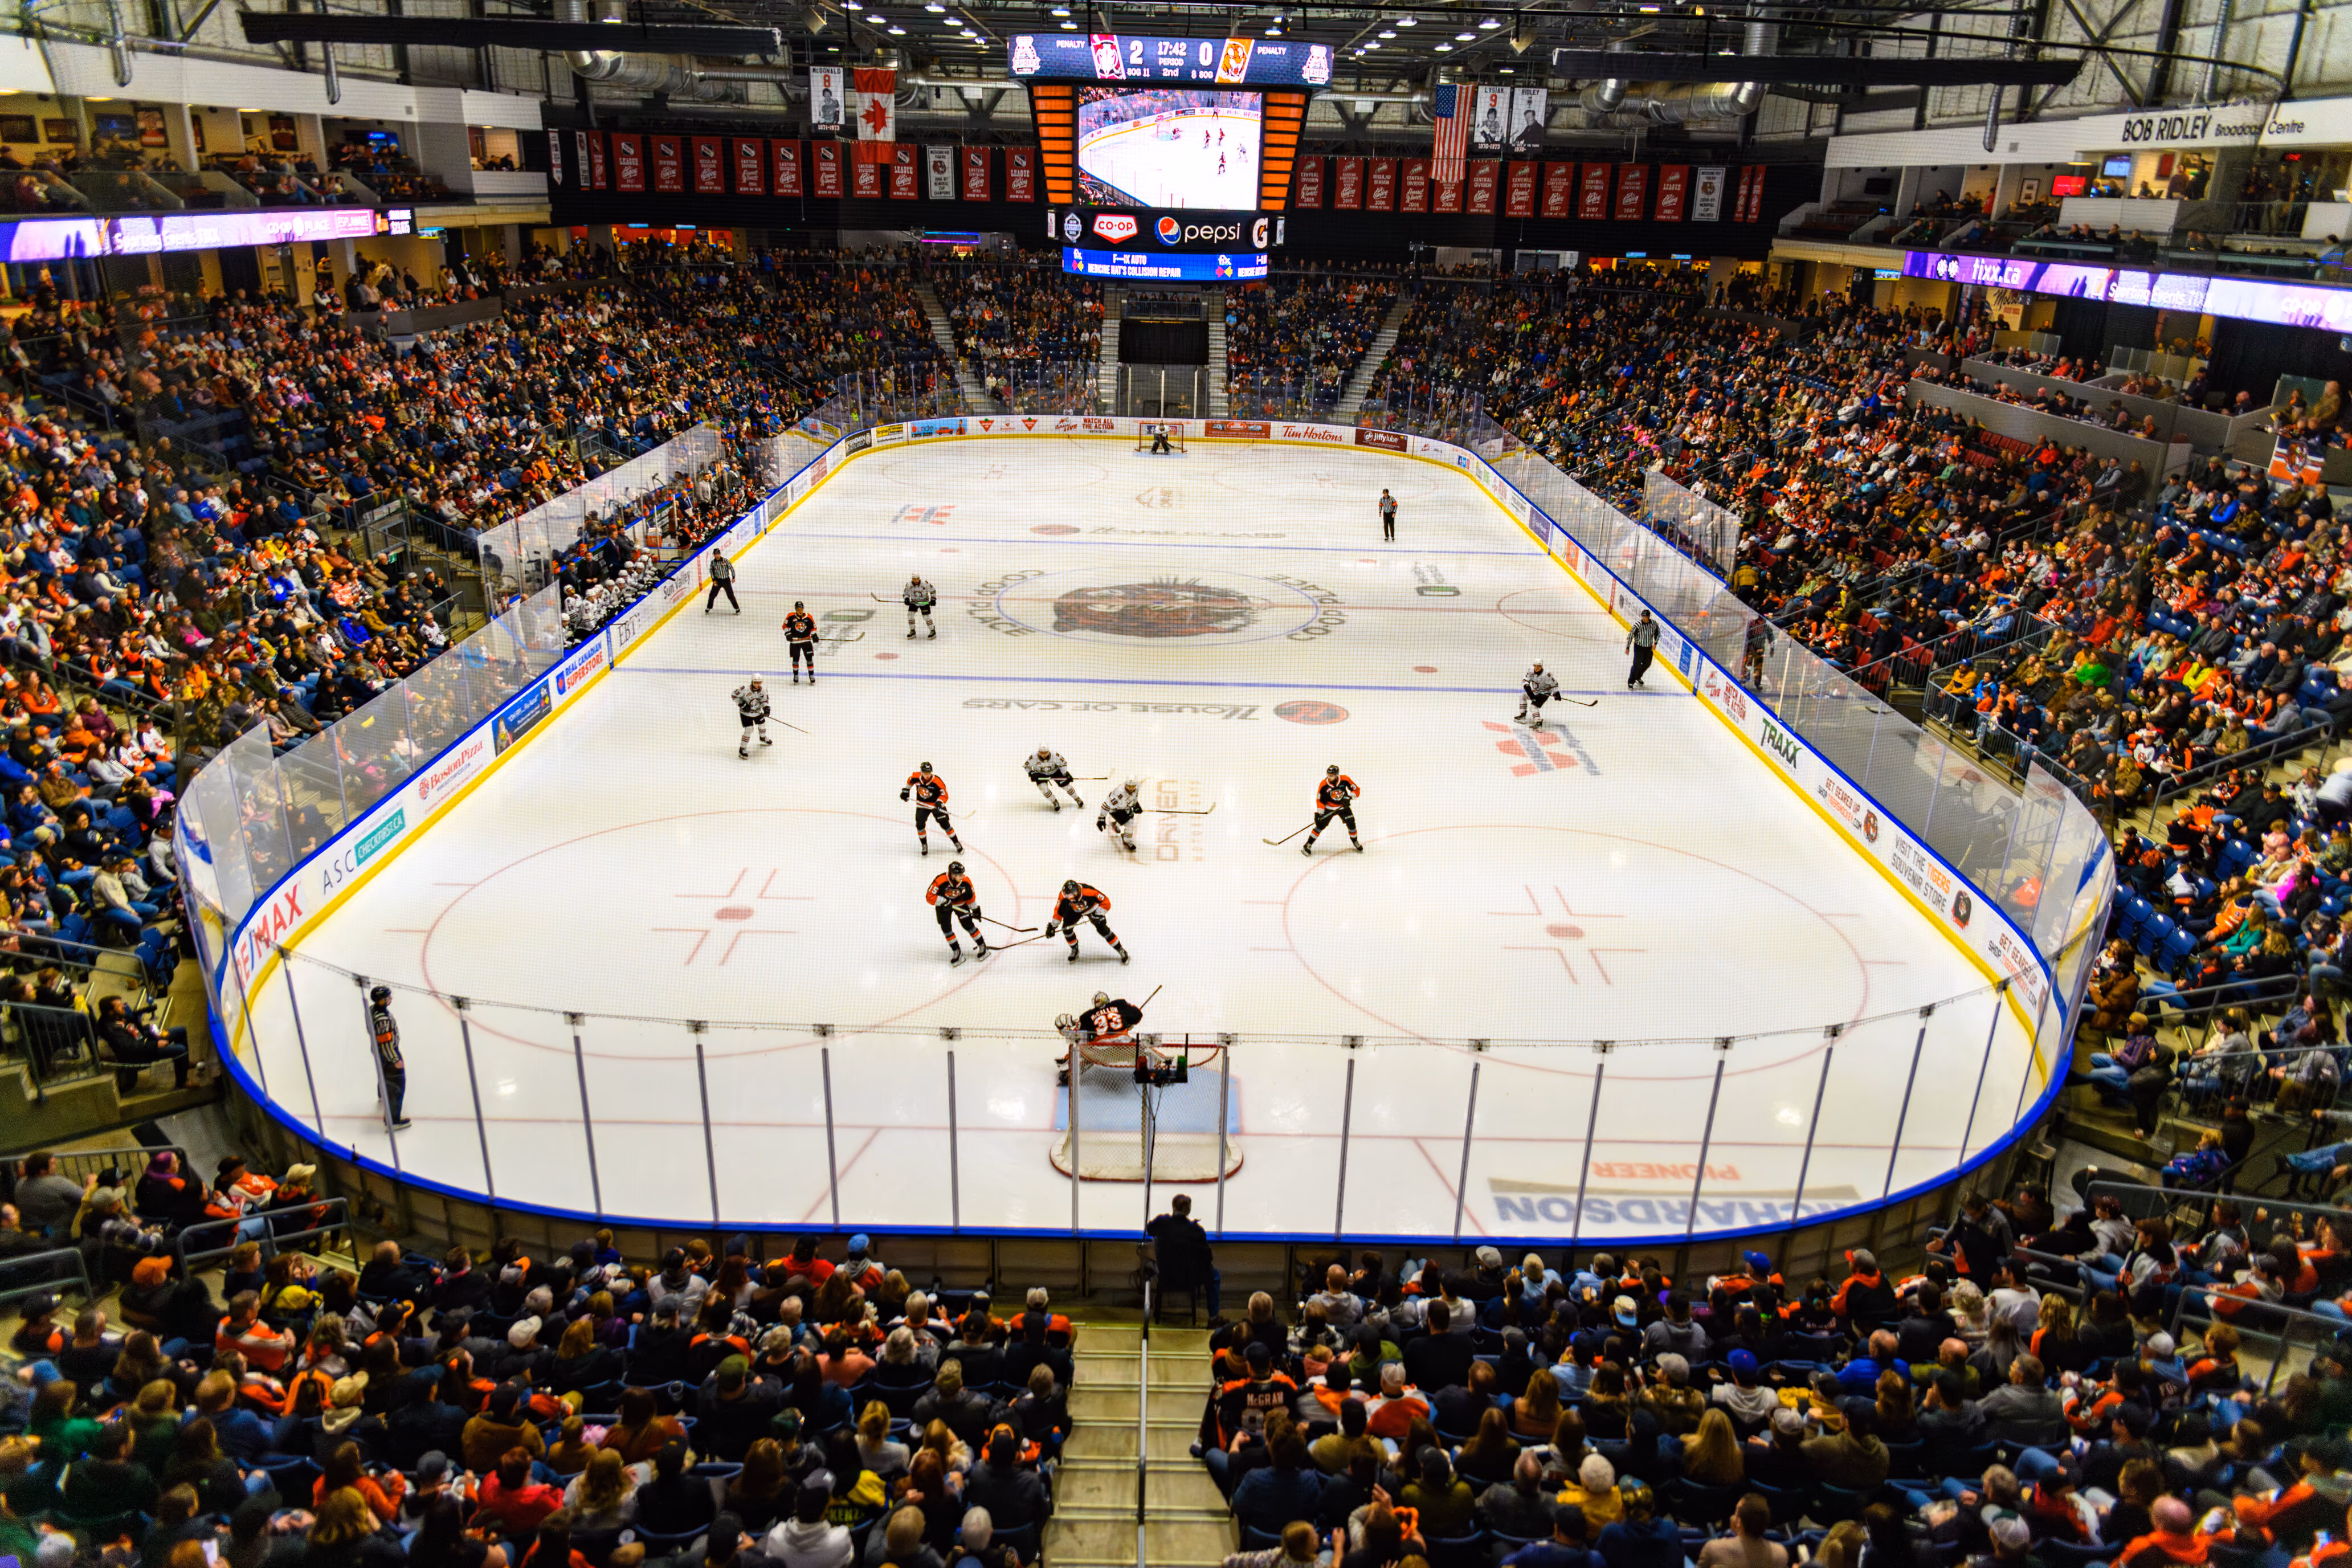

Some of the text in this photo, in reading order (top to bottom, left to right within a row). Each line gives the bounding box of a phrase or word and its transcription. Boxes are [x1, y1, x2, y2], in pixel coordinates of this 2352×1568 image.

[1056, 40, 1085, 48] PENALTY
[1129, 40, 1144, 64] 2
[1158, 42, 1186, 56] 17:42
[1199, 42, 1214, 67] 0
[1257, 46, 1287, 55] PENALTY
[1142, 68, 1151, 77] 11
[1158, 58, 1184, 67] PERIOD
[1162, 68, 1179, 77] 2nd
[823, 74, 831, 88] 8
[1191, 70, 1214, 79] 8 SOG
[1489, 93, 1498, 108] 9
[2122, 114, 2306, 142] BOB RIDLEY Centre
[114, 231, 162, 252] Sporting
[1185, 222, 1240, 243] pepsi
[1253, 218, 1268, 249] G
[1088, 263, 1181, 277] MEDICINE HAT'S COLLISION REPAIR
[1130, 255, 1148, 265] AUTO
[1971, 258, 2021, 285] tixx.ca
[2108, 280, 2188, 305] Sporting Events
[849, 435, 866, 447] SANDMAN
[1283, 426, 1301, 438] Tim
[1302, 426, 1343, 442] Hortons
[663, 583, 675, 599] Sun
[675, 570, 691, 590] Valley
[565, 640, 602, 676] REAL CANADIAN
[566, 651, 603, 690] SUPERSTORE
[1725, 681, 1738, 699] WATCH
[1730, 699, 1746, 721] ACTION
[1761, 717, 1802, 769] TRAXX
[1825, 777, 1860, 814] GET GEARED UP
[1895, 834, 1951, 895] VISIT THE TIGERS
[928, 884, 939, 895] 15
[1890, 855, 1948, 914] SOUVENIR STORE
[234, 883, 303, 991] RE/MAX
[1999, 932, 2037, 987] GET GEARED UP
[1091, 1006, 1119, 1020] McCALLUM
[1093, 1012, 1123, 1036] 33
[1594, 1161, 1741, 1181] PIONEER
[1246, 1391, 1284, 1407] McGRAW
